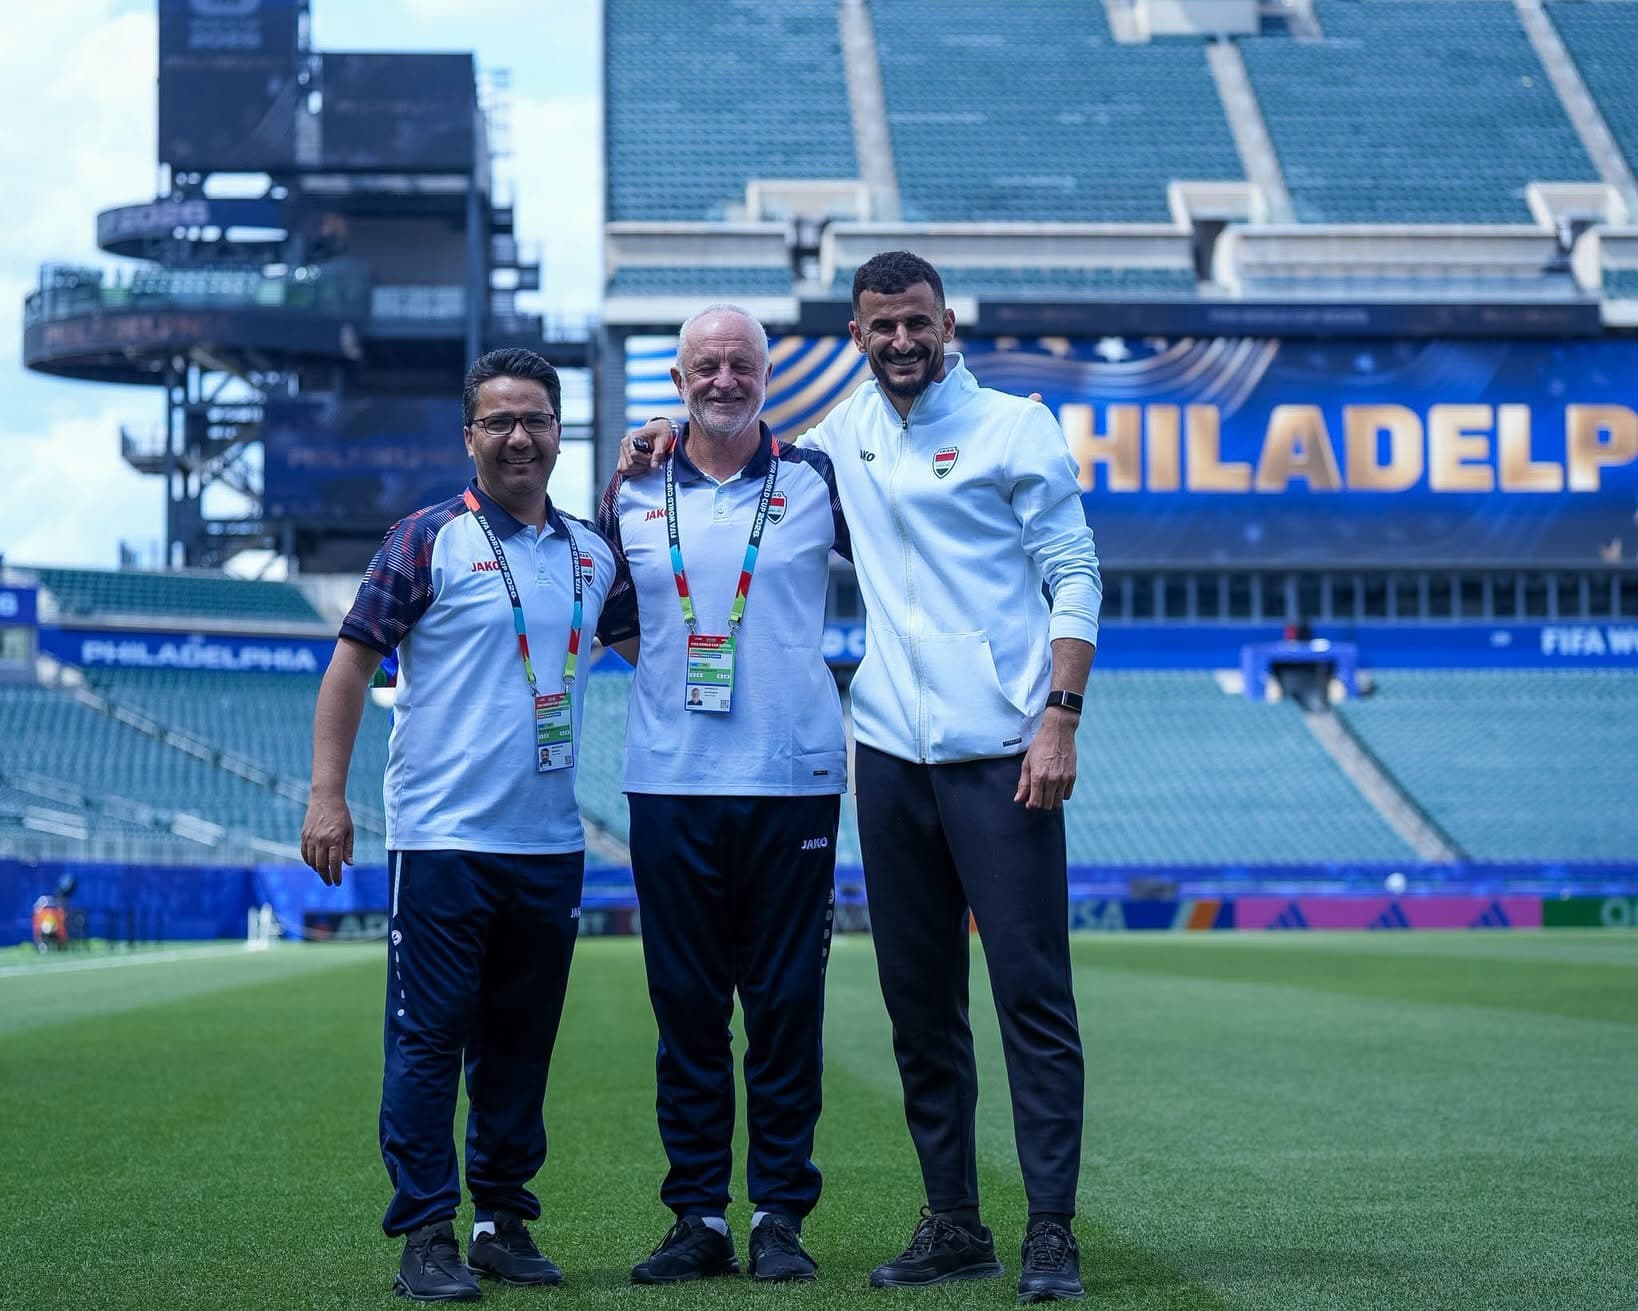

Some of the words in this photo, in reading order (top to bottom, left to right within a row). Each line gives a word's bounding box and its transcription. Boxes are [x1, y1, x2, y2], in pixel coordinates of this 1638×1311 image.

[1059, 404, 1638, 493] HILADELP
[764, 474, 775, 498] WORLD
[668, 497, 676, 523] WORLD
[760, 498, 769, 513] CUP
[752, 512, 765, 538] 2026
[478, 515, 490, 530] FIFA
[486, 529, 502, 555] WORLD
[499, 555, 508, 571] CUP
[472, 560, 500, 572] JAKO
[1541, 626, 1606, 656] FIFA
[81, 640, 317, 671] PHILADELPHIA
[801, 837, 828, 850] JAKO
